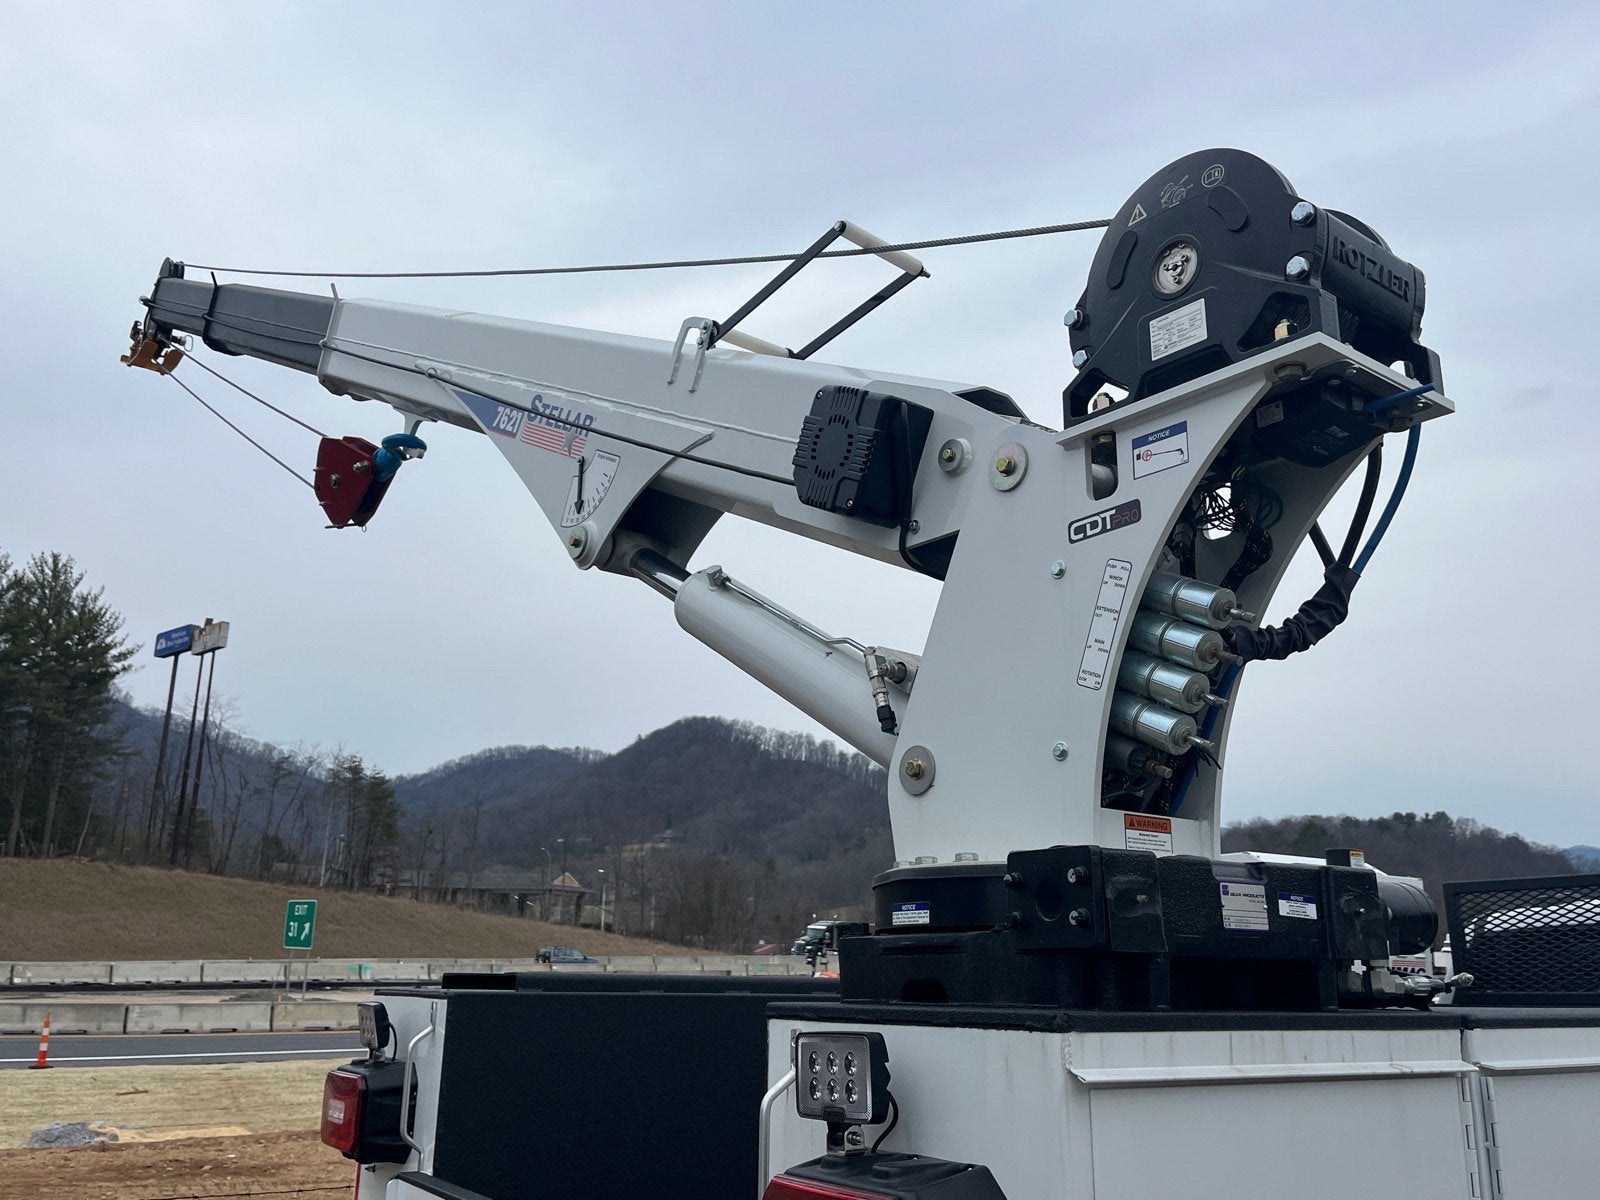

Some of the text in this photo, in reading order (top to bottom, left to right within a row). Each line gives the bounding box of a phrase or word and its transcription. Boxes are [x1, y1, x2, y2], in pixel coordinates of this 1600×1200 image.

[1333, 236, 1410, 302] ROTZLER
[492, 406, 523, 434] 7621
[527, 394, 595, 437] STELLAR
[1147, 429, 1171, 442] NOTICE
[1096, 605, 1119, 615] EXTENSION
[1081, 669, 1102, 679] ROTATION
[1136, 820, 1168, 830] WARNING
[294, 904, 308, 915] EXIT
[288, 921, 298, 937] 31
